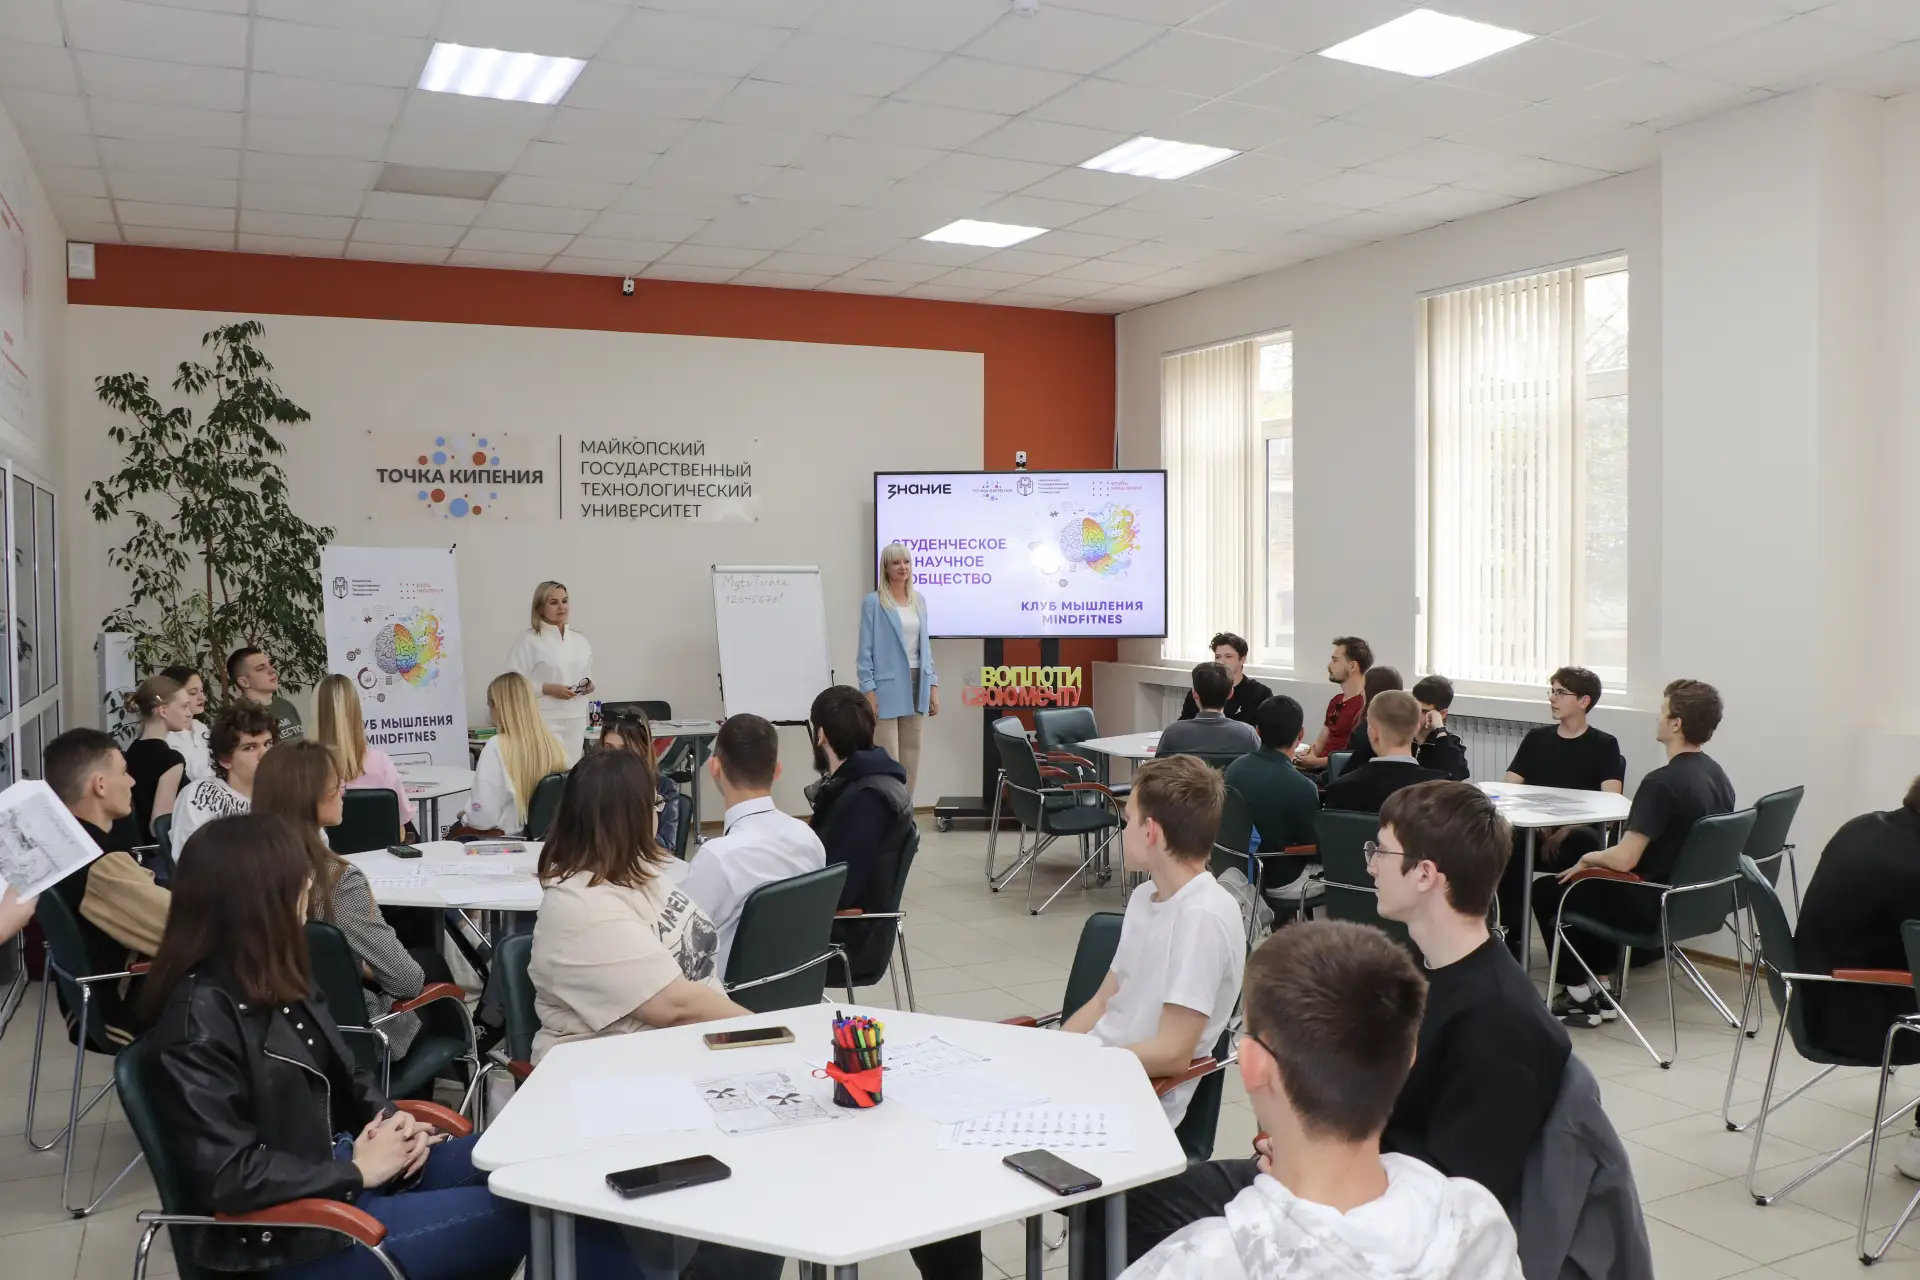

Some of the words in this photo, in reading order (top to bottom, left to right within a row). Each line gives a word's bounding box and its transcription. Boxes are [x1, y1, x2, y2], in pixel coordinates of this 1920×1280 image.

[581, 437, 705, 456] МАЙКОПСКИЙ
[376, 468, 445, 484] ТОЧКА
[450, 469, 543, 484] КИПЕНИЯ
[581, 461, 752, 478] ГОСУДАРСТВЕННЫЙ
[581, 481, 752, 498] ТЕХНОЛОГИЧЕСКИЙ
[581, 503, 702, 518] УНИВЕРСИТЕТ
[915, 556, 985, 568] НАУЧНОЕ
[1021, 601, 1057, 612] КЛУБ
[1061, 600, 1144, 611] МЫШЛЕНИЯ
[1042, 614, 1123, 625] MINDFITNES
[981, 665, 1082, 688] ВОПЛОТИ
[381, 714, 453, 730] МЫШЛЕНИЯ
